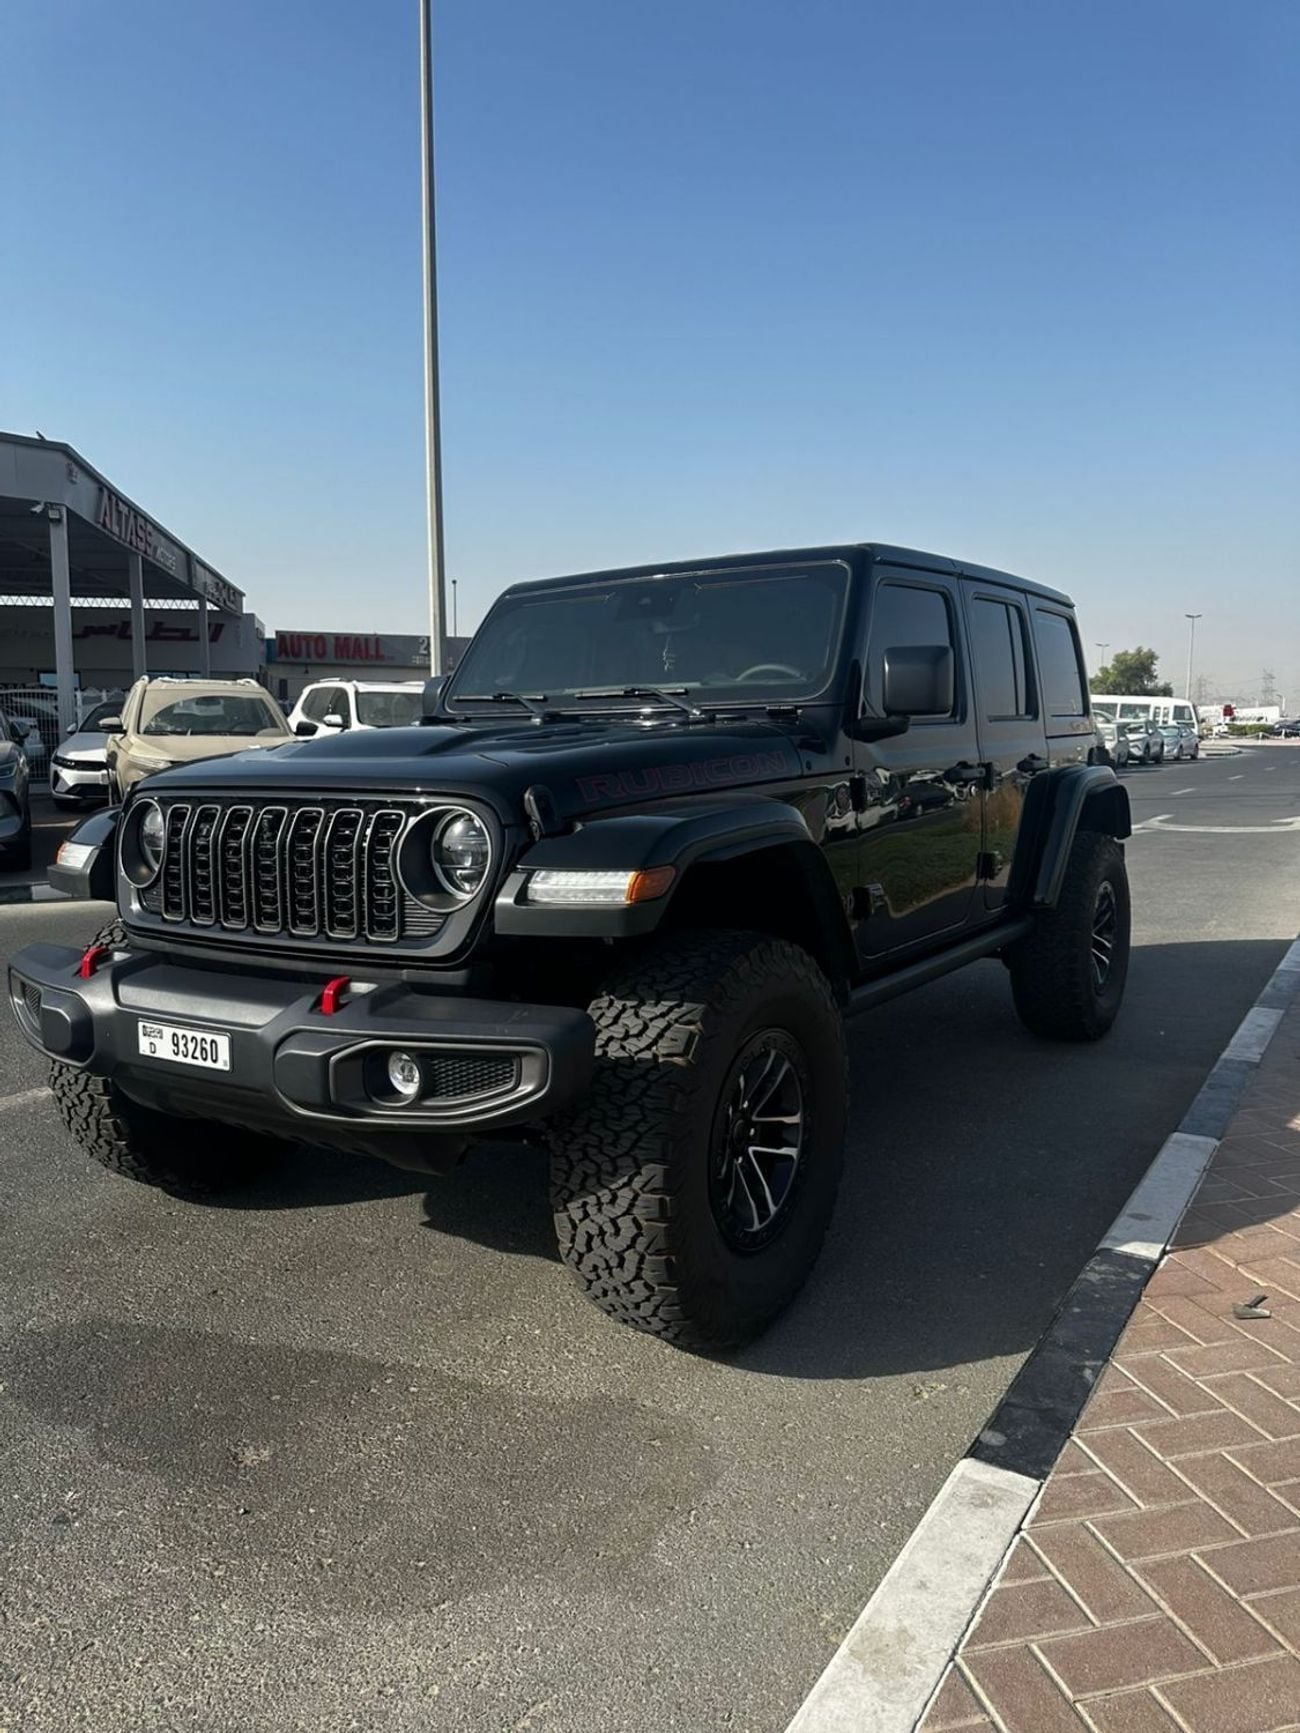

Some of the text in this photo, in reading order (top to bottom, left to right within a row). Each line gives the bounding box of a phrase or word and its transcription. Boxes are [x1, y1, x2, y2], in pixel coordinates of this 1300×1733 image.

[277, 634, 385, 662] AUTO MALL
[575, 750, 788, 802] RUBICON
[149, 1041, 157, 1055] D
[171, 1031, 219, 1064] 93260
